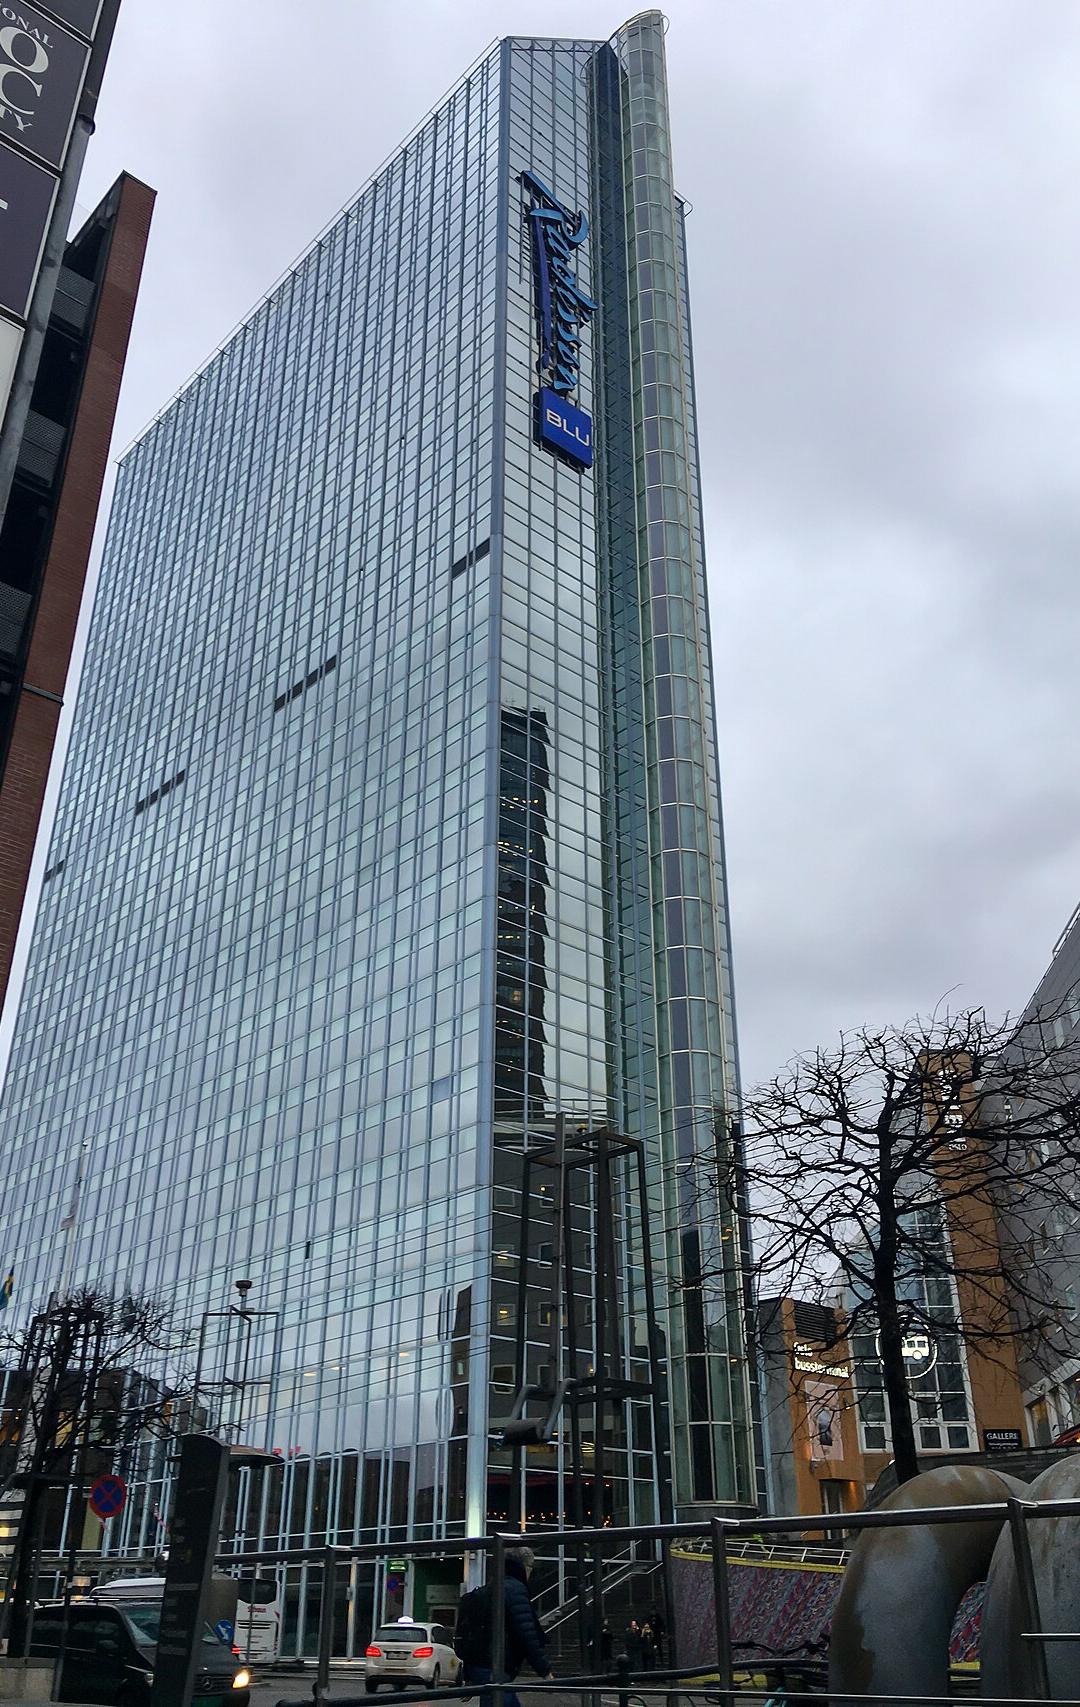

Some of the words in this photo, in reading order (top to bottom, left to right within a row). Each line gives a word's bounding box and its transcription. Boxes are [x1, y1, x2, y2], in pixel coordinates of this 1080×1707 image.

[0, 7, 54, 48] ONAL
[521, 170, 598, 391] Radisson
[546, 408, 590, 447] BLU
